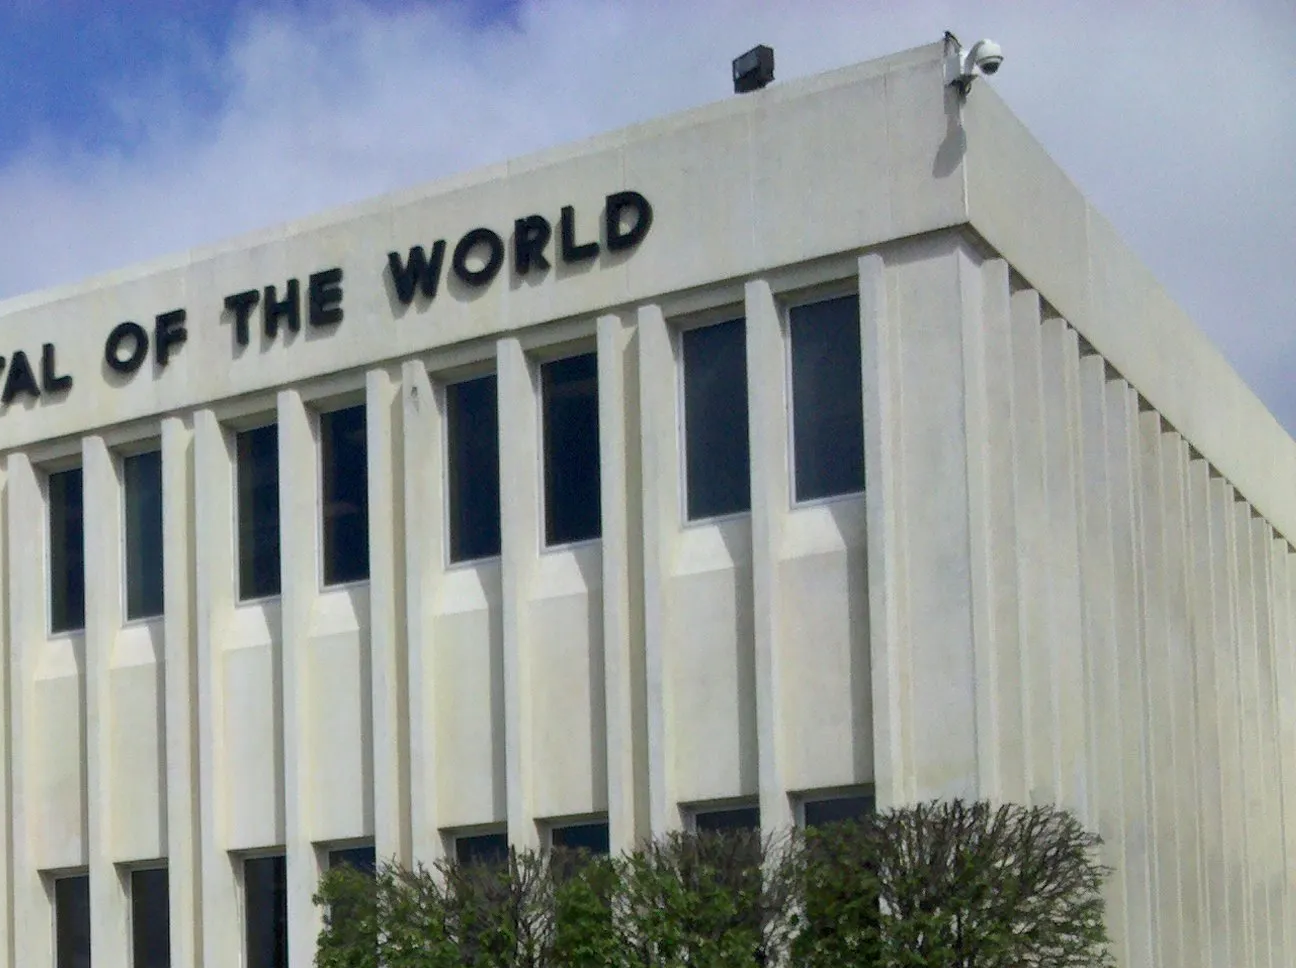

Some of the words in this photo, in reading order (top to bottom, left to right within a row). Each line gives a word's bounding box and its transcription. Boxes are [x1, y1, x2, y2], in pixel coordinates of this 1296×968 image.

[104, 309, 187, 372] OF
[224, 268, 343, 346] THE
[387, 190, 653, 302] WORLD
